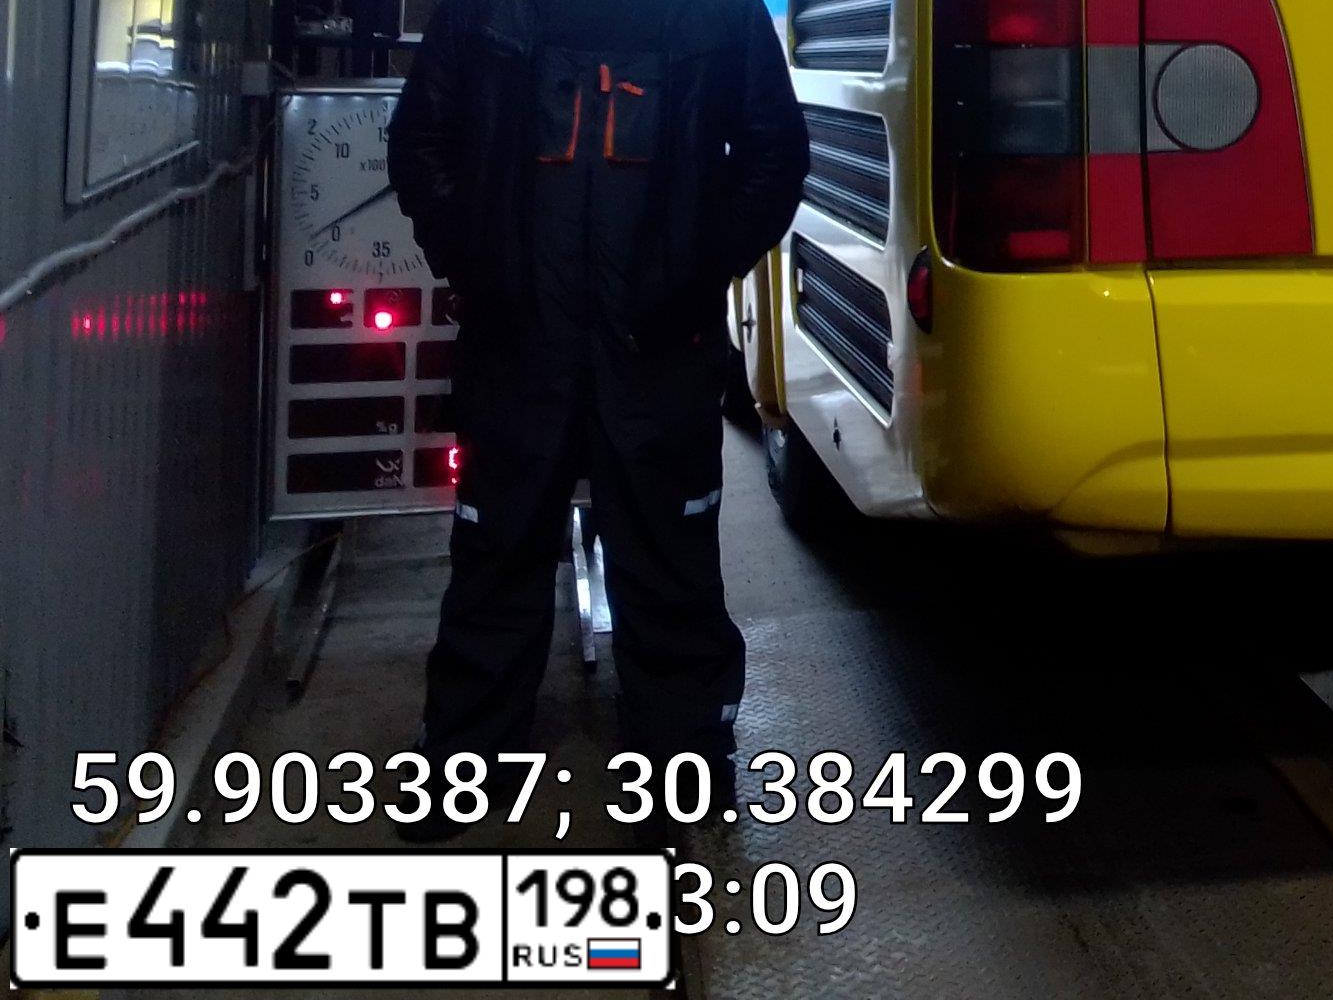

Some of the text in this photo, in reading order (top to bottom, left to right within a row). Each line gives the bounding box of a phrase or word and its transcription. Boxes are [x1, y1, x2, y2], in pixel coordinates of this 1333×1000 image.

[307, 118, 318, 136] 2
[335, 142, 350, 159] 10
[310, 184, 319, 201] 5
[331, 225, 341, 242] 0
[372, 241, 391, 258] 35
[304, 250, 314, 267] 0
